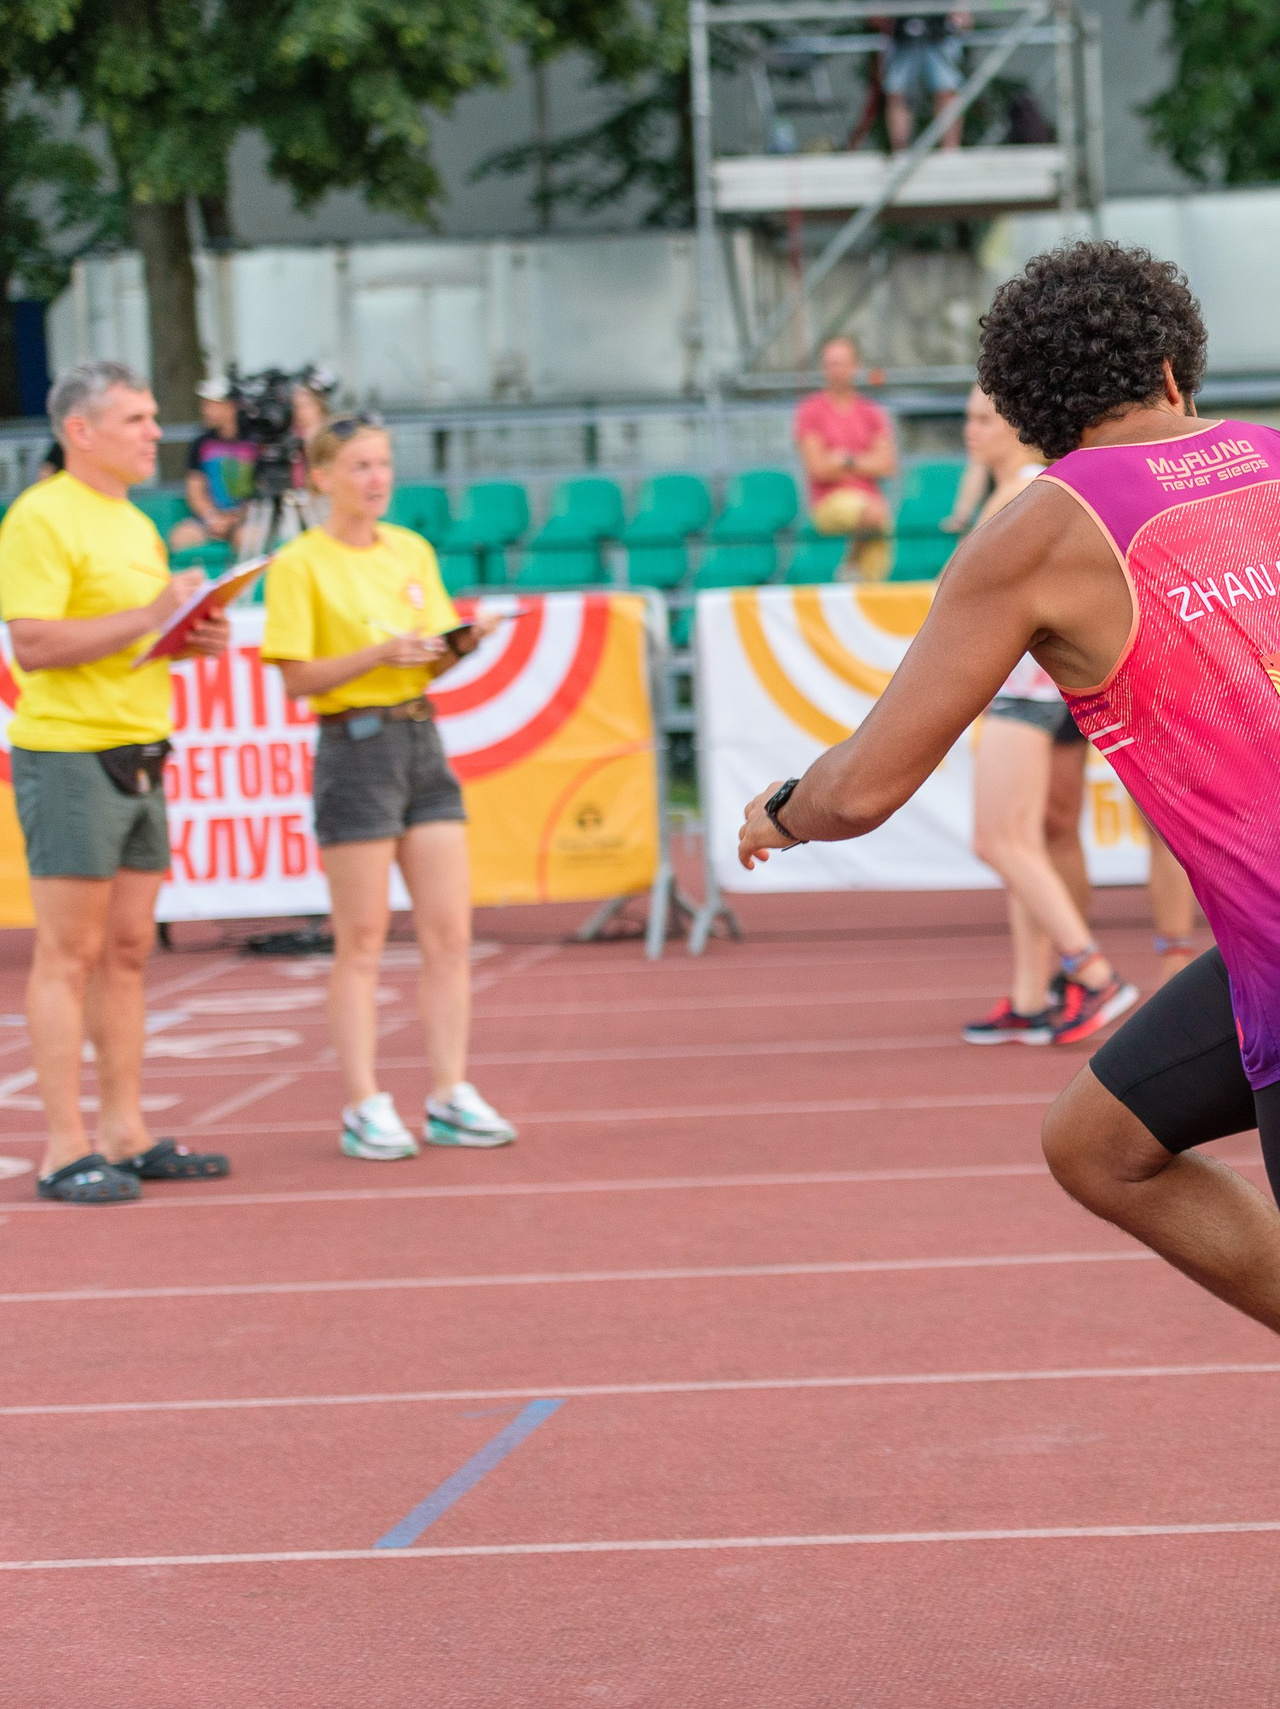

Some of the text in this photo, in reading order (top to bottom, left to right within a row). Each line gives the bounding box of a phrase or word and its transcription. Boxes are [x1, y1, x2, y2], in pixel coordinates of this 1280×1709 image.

[1161, 459, 1269, 492] never sleeps
[1166, 563, 1276, 622] ZHAN
